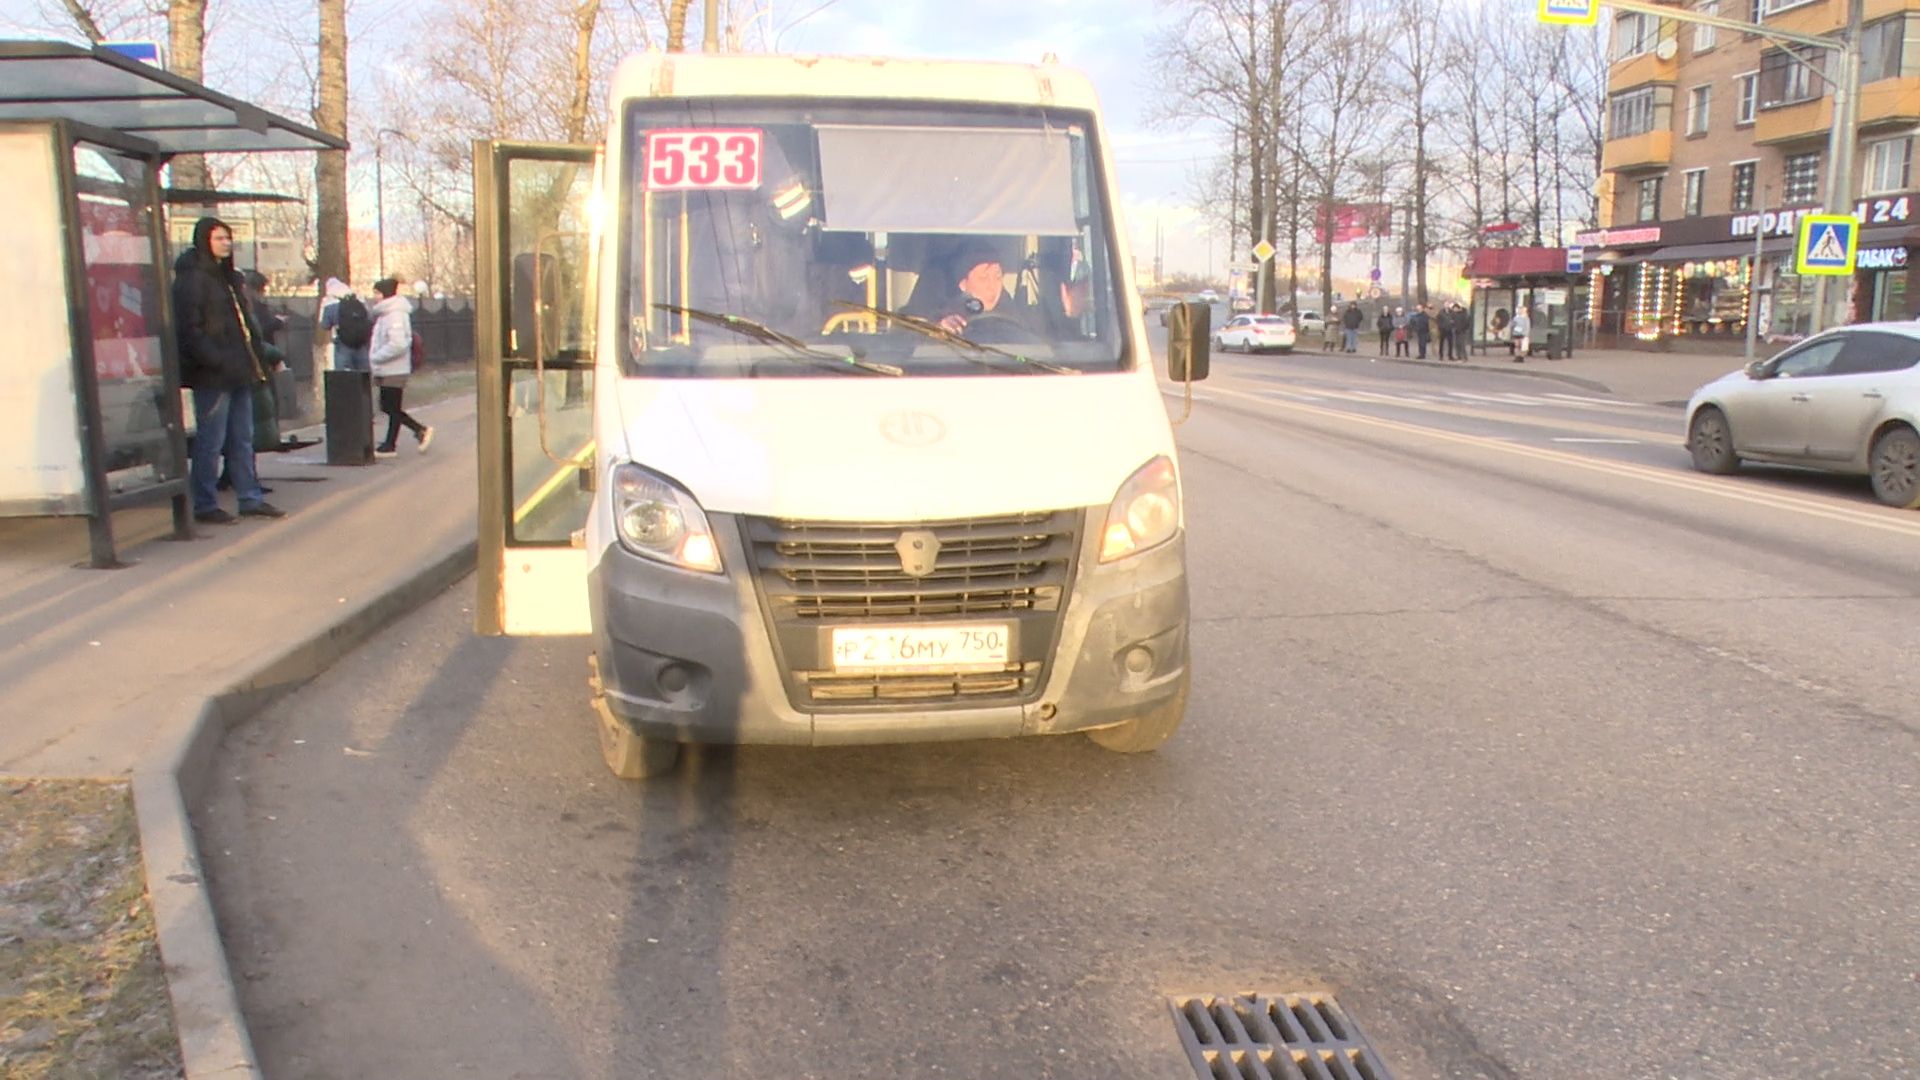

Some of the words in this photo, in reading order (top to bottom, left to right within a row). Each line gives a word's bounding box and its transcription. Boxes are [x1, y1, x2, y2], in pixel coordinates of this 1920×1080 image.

[652, 135, 756, 186] 533
[1731, 202, 1868, 236] ПРОД
[1872, 197, 1909, 223] 24
[1857, 248, 1895, 268] ТАБАК
[959, 631, 999, 650] 750
